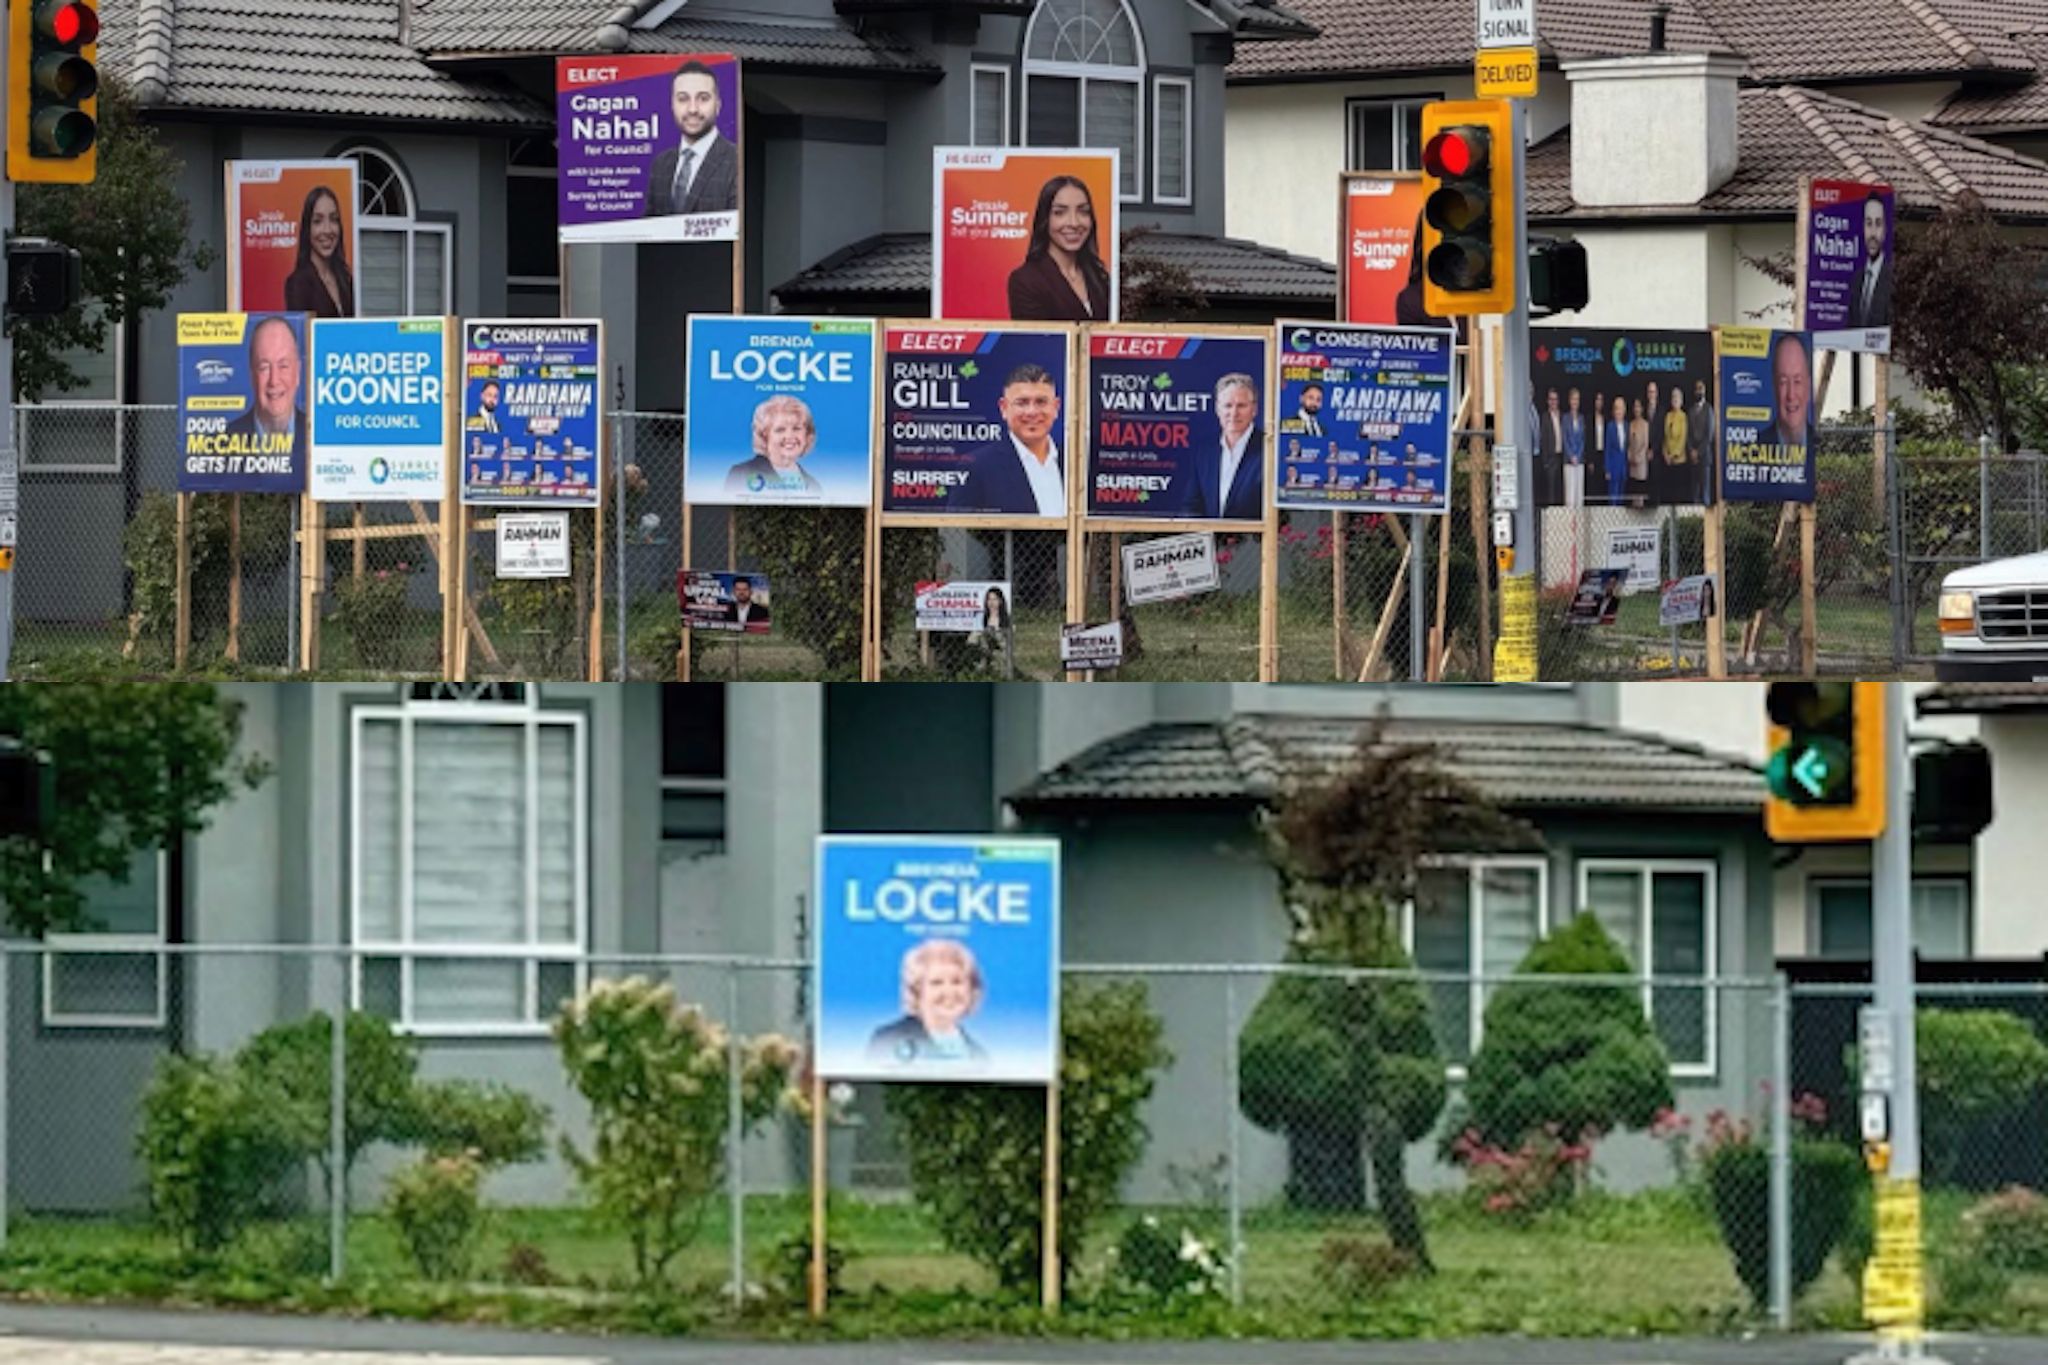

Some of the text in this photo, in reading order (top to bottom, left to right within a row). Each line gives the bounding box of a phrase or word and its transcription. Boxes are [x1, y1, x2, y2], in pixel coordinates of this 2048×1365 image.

[1483, 19, 1530, 38] SIGNAL
[567, 67, 619, 83] ELECT
[1479, 64, 1532, 84] DELAYED
[570, 95, 639, 115] Gagan
[572, 114, 659, 140] Nahal
[584, 143, 652, 156] for Council
[684, 217, 732, 228] SURREY
[951, 208, 1029, 226] Sunner
[1814, 213, 1850, 233] Gagan
[245, 219, 297, 235] Sunner
[1352, 239, 1409, 257] Sunner
[1814, 234, 1859, 258] Nahal
[491, 327, 590, 344] CONSERVATIVE
[750, 335, 814, 348] BRENDA
[901, 333, 966, 350] ELECT
[1315, 331, 1440, 352] CONSERVATIVE
[1104, 338, 1168, 355] ELECT
[1554, 347, 1604, 362] BRENDA
[1636, 343, 1686, 355] SURREY
[326, 353, 431, 374] PARDEEP
[710, 350, 853, 382] LOCKE
[893, 362, 958, 379] RAHUL
[1331, 357, 1363, 368] PARTY
[1365, 358, 1379, 369] OF
[1635, 357, 1686, 371] CONNECT
[317, 376, 441, 405] KOONER
[1101, 374, 1150, 390] TROY
[504, 382, 592, 406] RANDHAWA
[893, 380, 970, 409] GILL
[1101, 392, 1212, 412] VAN VLIET
[1330, 386, 1442, 413] RANDHAWA
[186, 417, 227, 433] DOUG
[335, 414, 420, 429] FOR COUNCIL
[893, 423, 1001, 441] COUNCILLOR
[1100, 422, 1190, 448] MAYOR
[1726, 427, 1758, 442] DOUG
[187, 433, 294, 454] McCALLUM
[1726, 443, 1807, 465] McCALLUM
[186, 456, 293, 474] GETS IT DONE.
[316, 464, 355, 475] BRENDA
[390, 471, 439, 481] CONNECT
[892, 470, 969, 485] SURREY
[1096, 474, 1172, 491] SURREY
[1726, 465, 1807, 483] GETS IT DONE.
[892, 485, 938, 498] NOW
[1095, 489, 1138, 503] NOW
[504, 526, 561, 541] RAHMAN
[1611, 539, 1655, 555] RAHMAN
[1134, 546, 1206, 570] RAHMAN
[845, 879, 1031, 923] LOCKE
